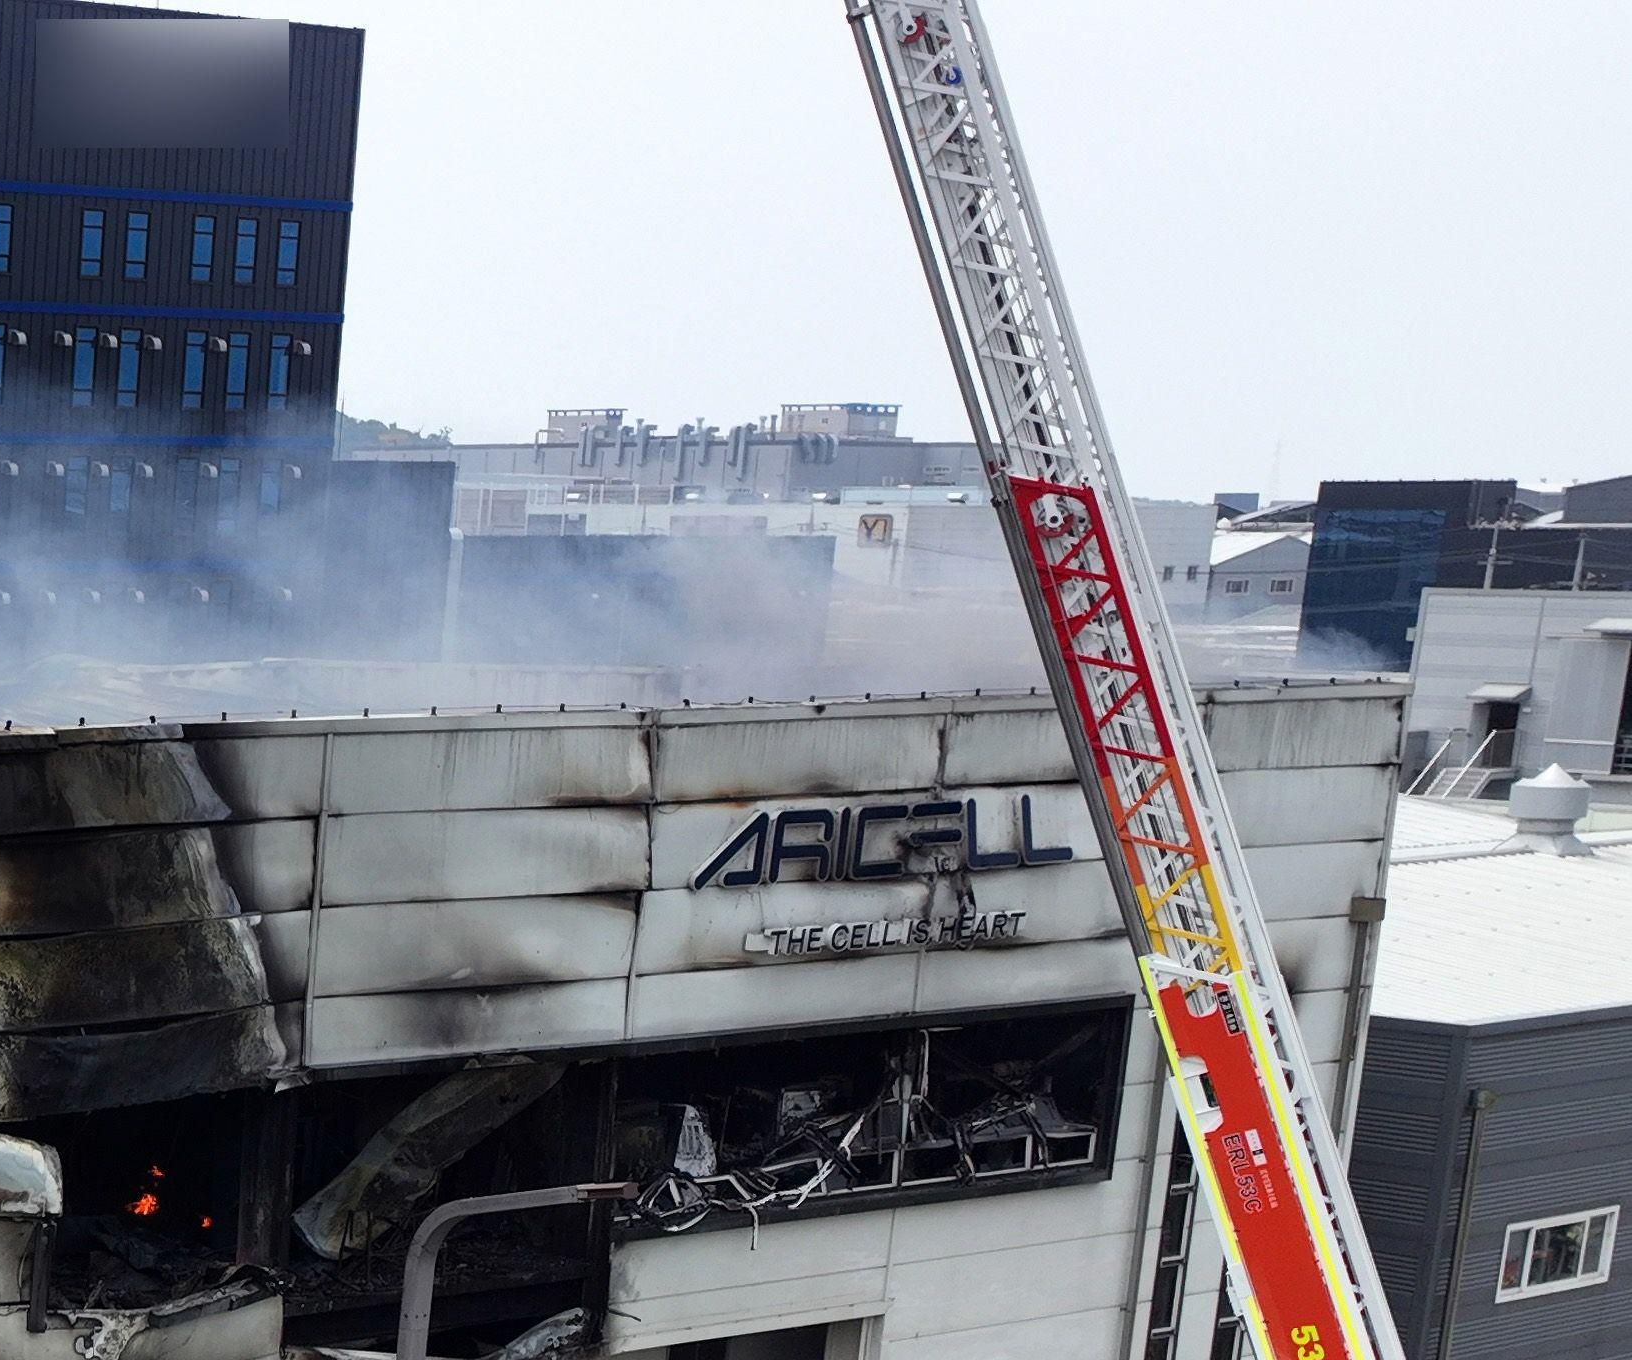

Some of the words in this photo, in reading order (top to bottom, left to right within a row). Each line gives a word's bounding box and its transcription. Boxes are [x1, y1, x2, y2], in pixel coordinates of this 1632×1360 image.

[688, 793, 1074, 891] ARICELL
[767, 926, 824, 956] THE
[830, 922, 897, 952] CELL
[905, 918, 930, 945] IS
[937, 911, 1027, 950] HEART
